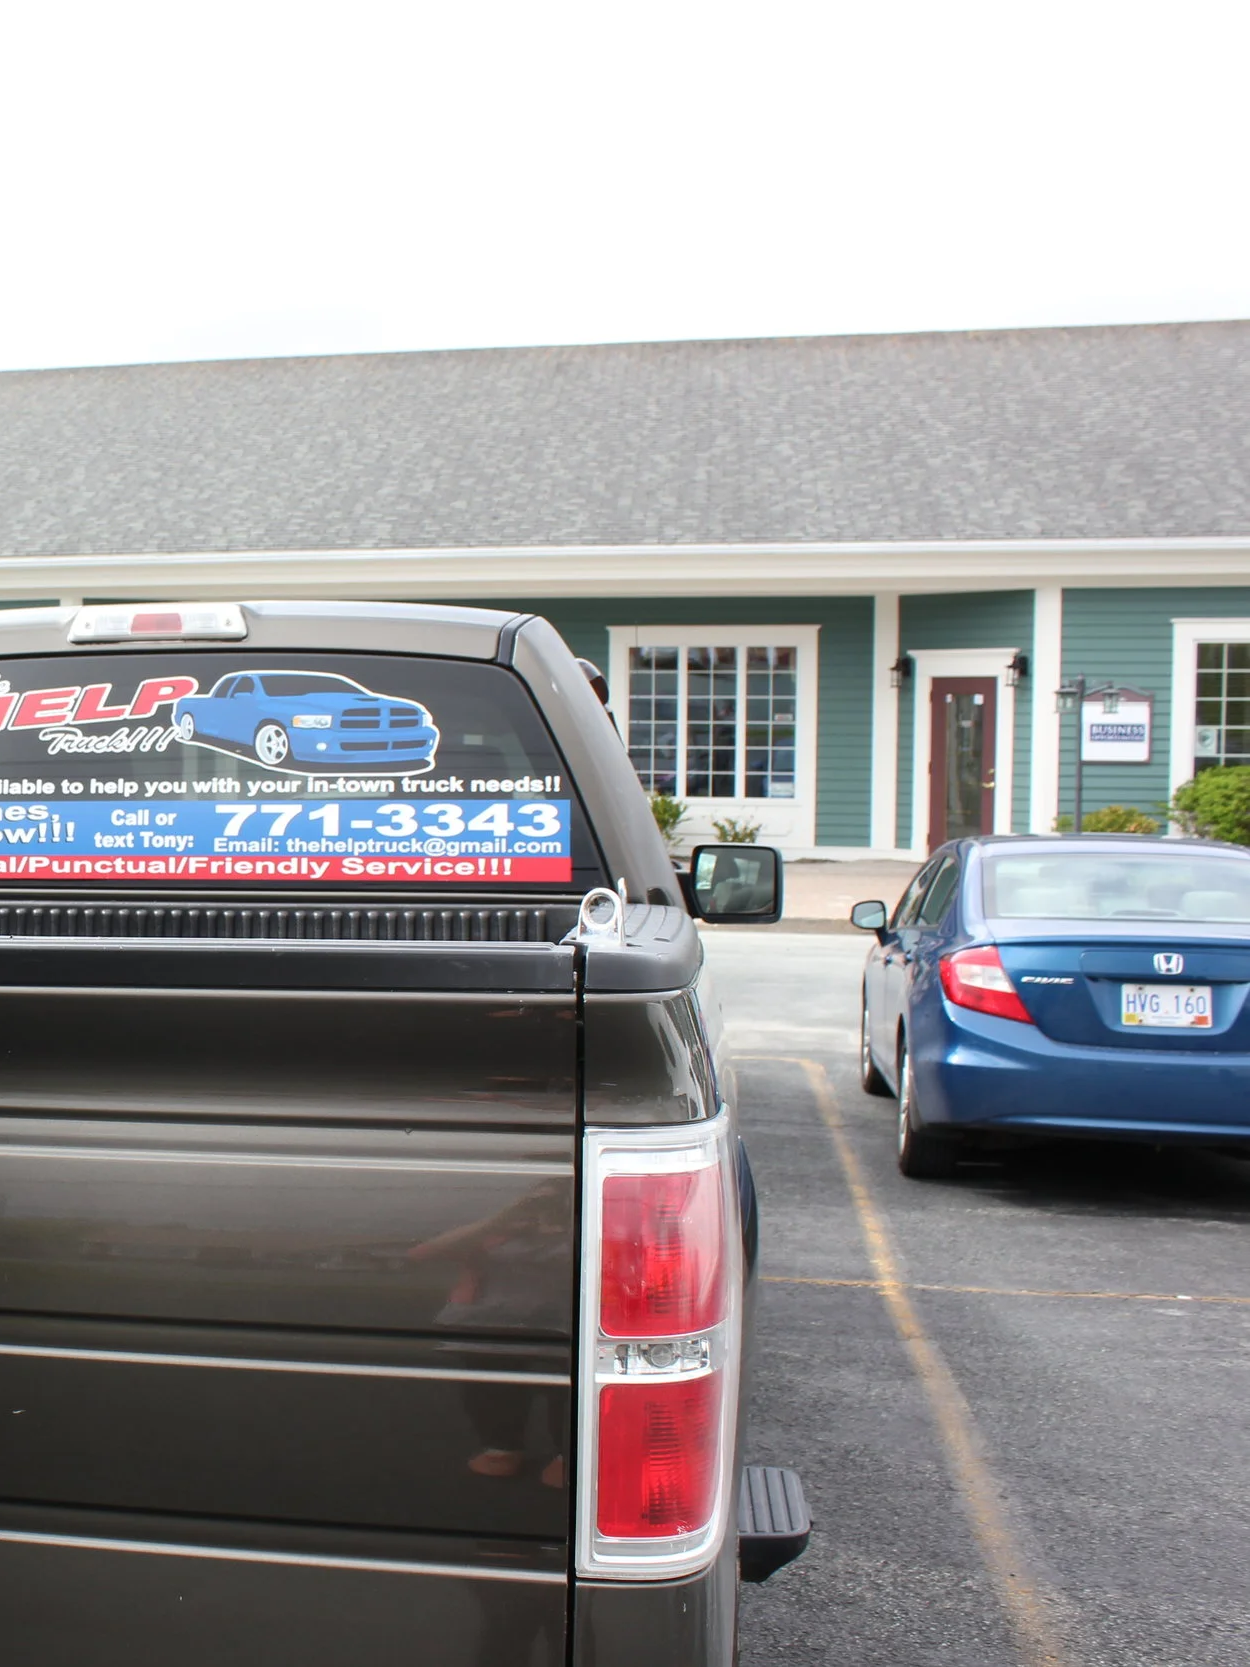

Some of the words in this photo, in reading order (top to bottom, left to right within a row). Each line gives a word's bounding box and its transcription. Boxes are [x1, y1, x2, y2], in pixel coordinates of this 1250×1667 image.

[39, 726, 181, 755] Truck!!!
[1092, 726, 1144, 735] BUSINESS
[61, 779, 84, 794] to
[90, 778, 138, 797] help
[144, 780, 187, 797] you
[192, 777, 240, 793] with
[247, 779, 302, 797] your
[307, 776, 395, 793] in-town
[401, 776, 464, 792] truck
[471, 775, 561, 793] needs!!
[111, 809, 149, 826] Call
[155, 813, 177, 826] or
[215, 803, 561, 837] 771-3343
[94, 832, 135, 848] text
[140, 831, 194, 852] Tony:
[213, 837, 280, 852] Email:
[286, 837, 562, 857] thehelptruck@gmail.com
[341, 857, 512, 875] Service!!!
[1126, 993, 1160, 1013] HVG
[1174, 995, 1207, 1015] 160
